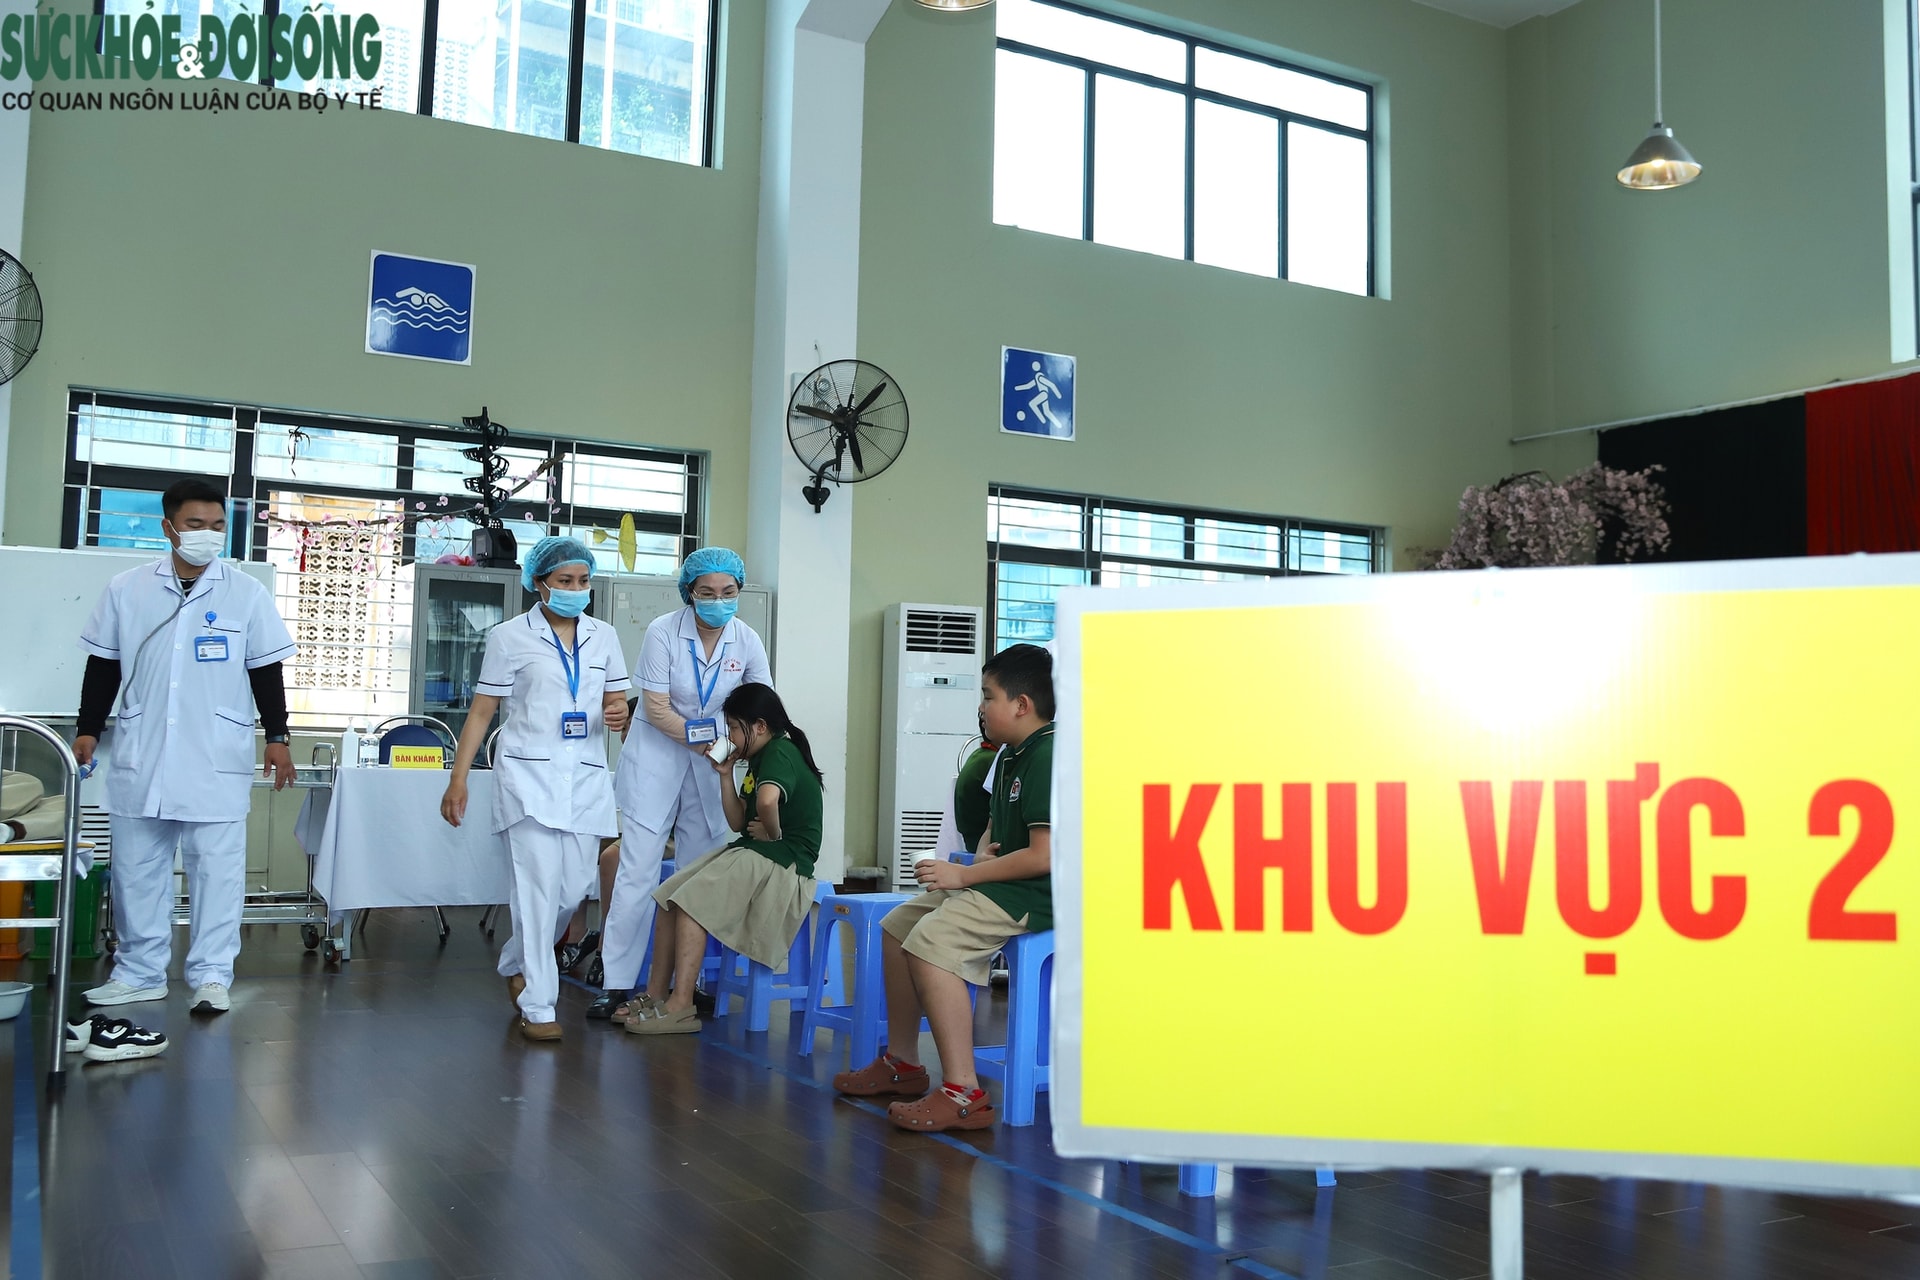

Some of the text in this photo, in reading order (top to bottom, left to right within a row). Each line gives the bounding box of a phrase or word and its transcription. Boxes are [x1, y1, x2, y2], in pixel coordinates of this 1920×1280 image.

[1142, 761, 1898, 976] KHU VỰC 2
